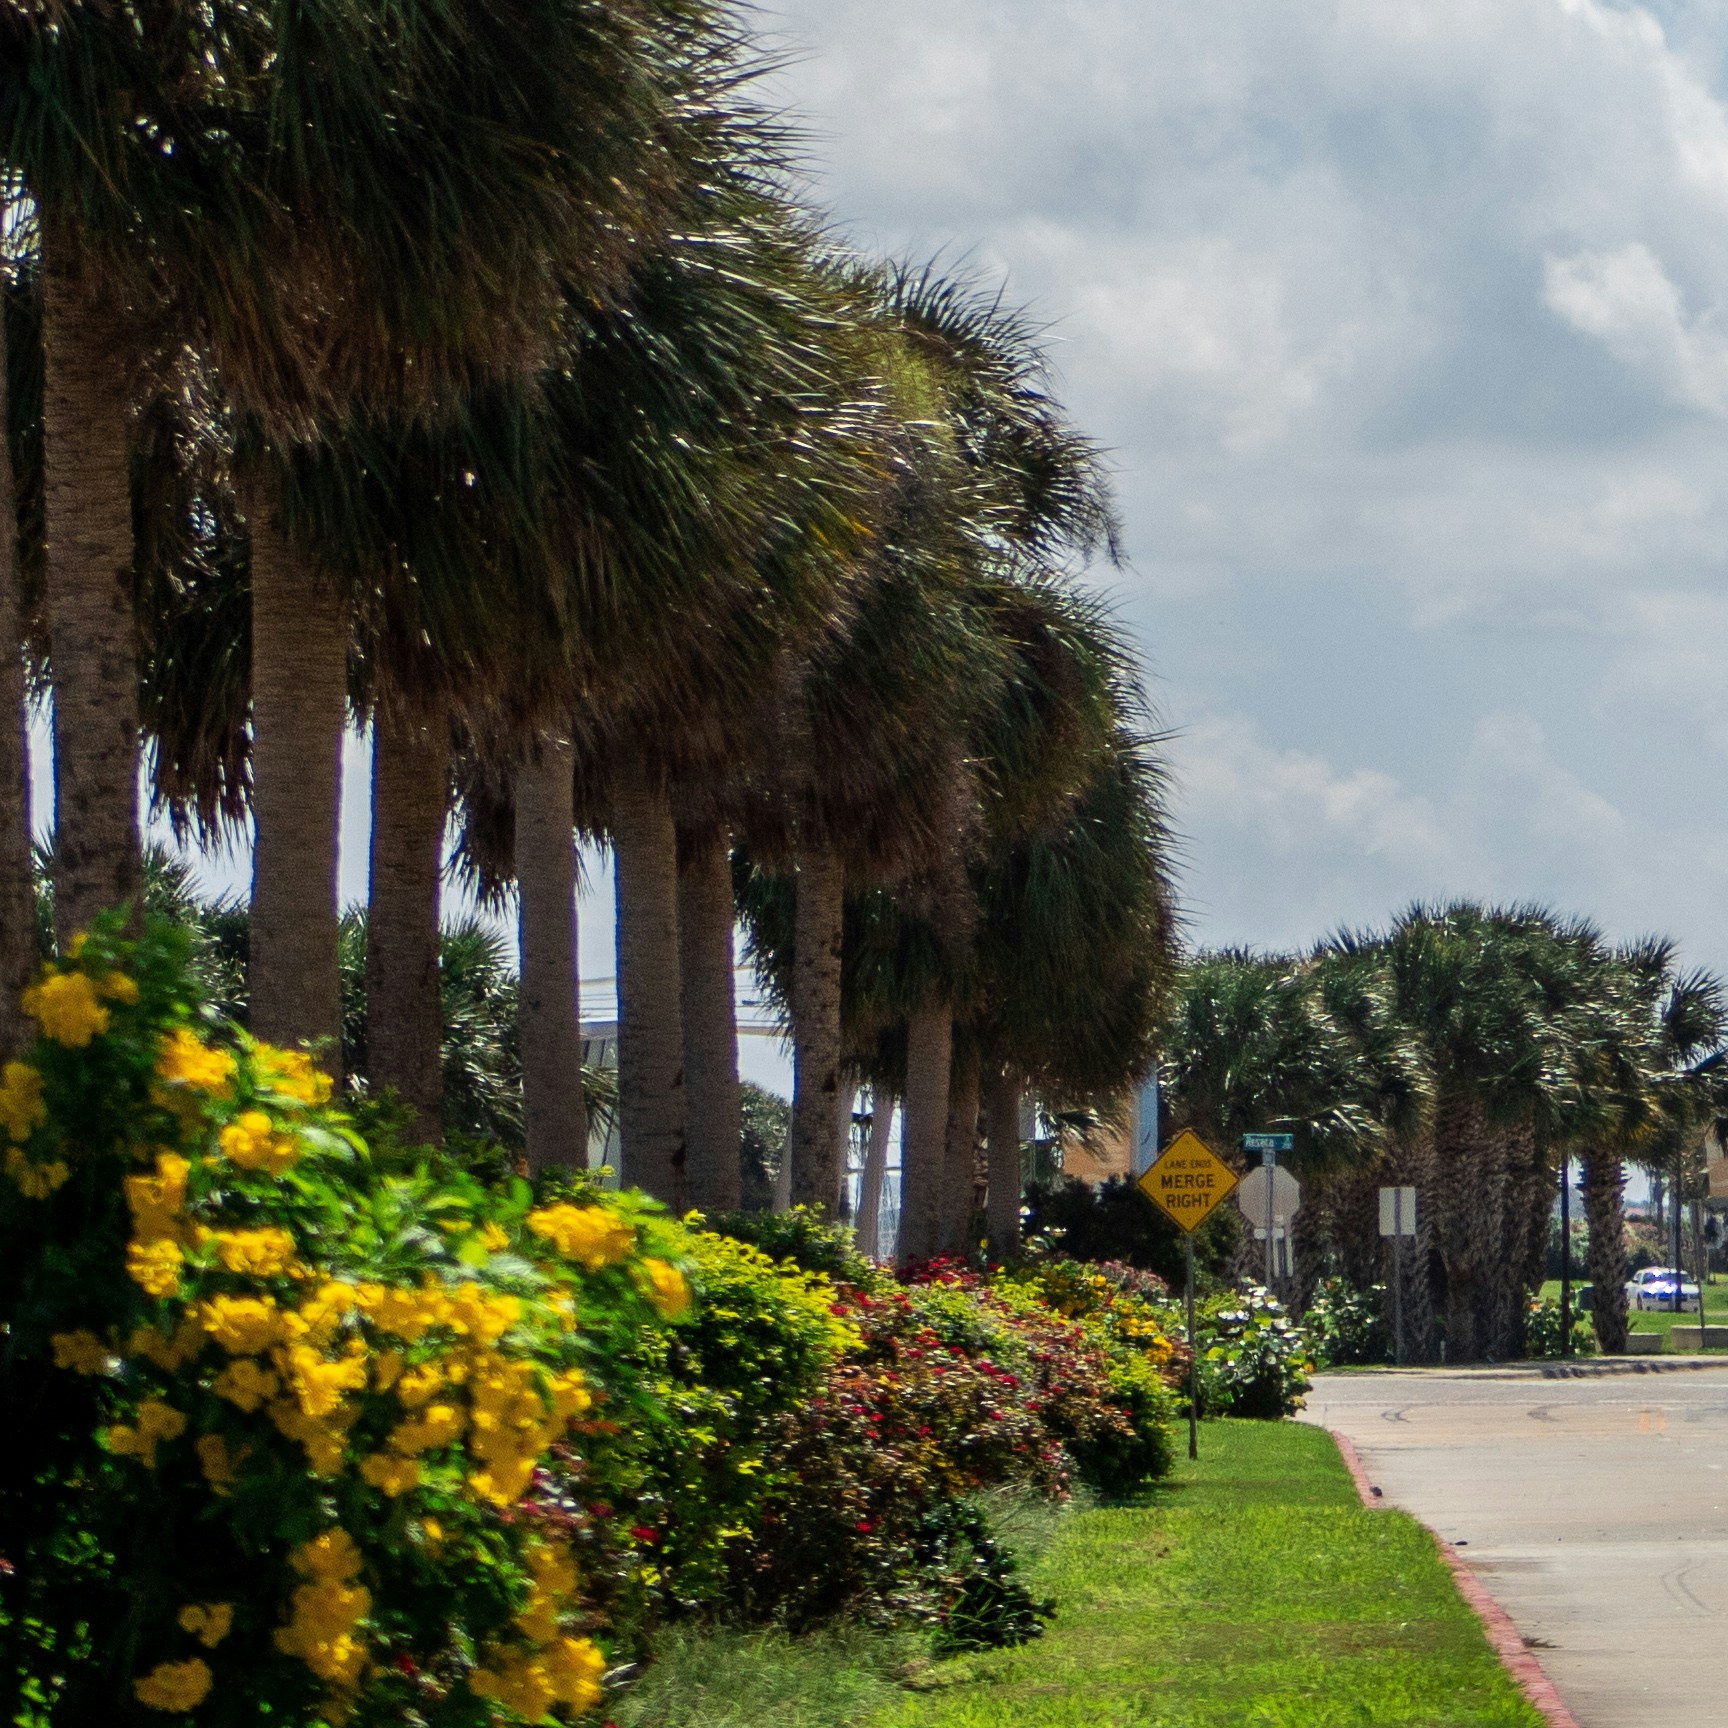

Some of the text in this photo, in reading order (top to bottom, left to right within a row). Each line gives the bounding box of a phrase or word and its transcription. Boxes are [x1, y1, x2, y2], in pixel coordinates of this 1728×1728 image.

[1163, 1158, 1212, 1170] LANE ENDS
[1161, 1173, 1216, 1189] MERGE
[1166, 1193, 1212, 1209] RIGHT
